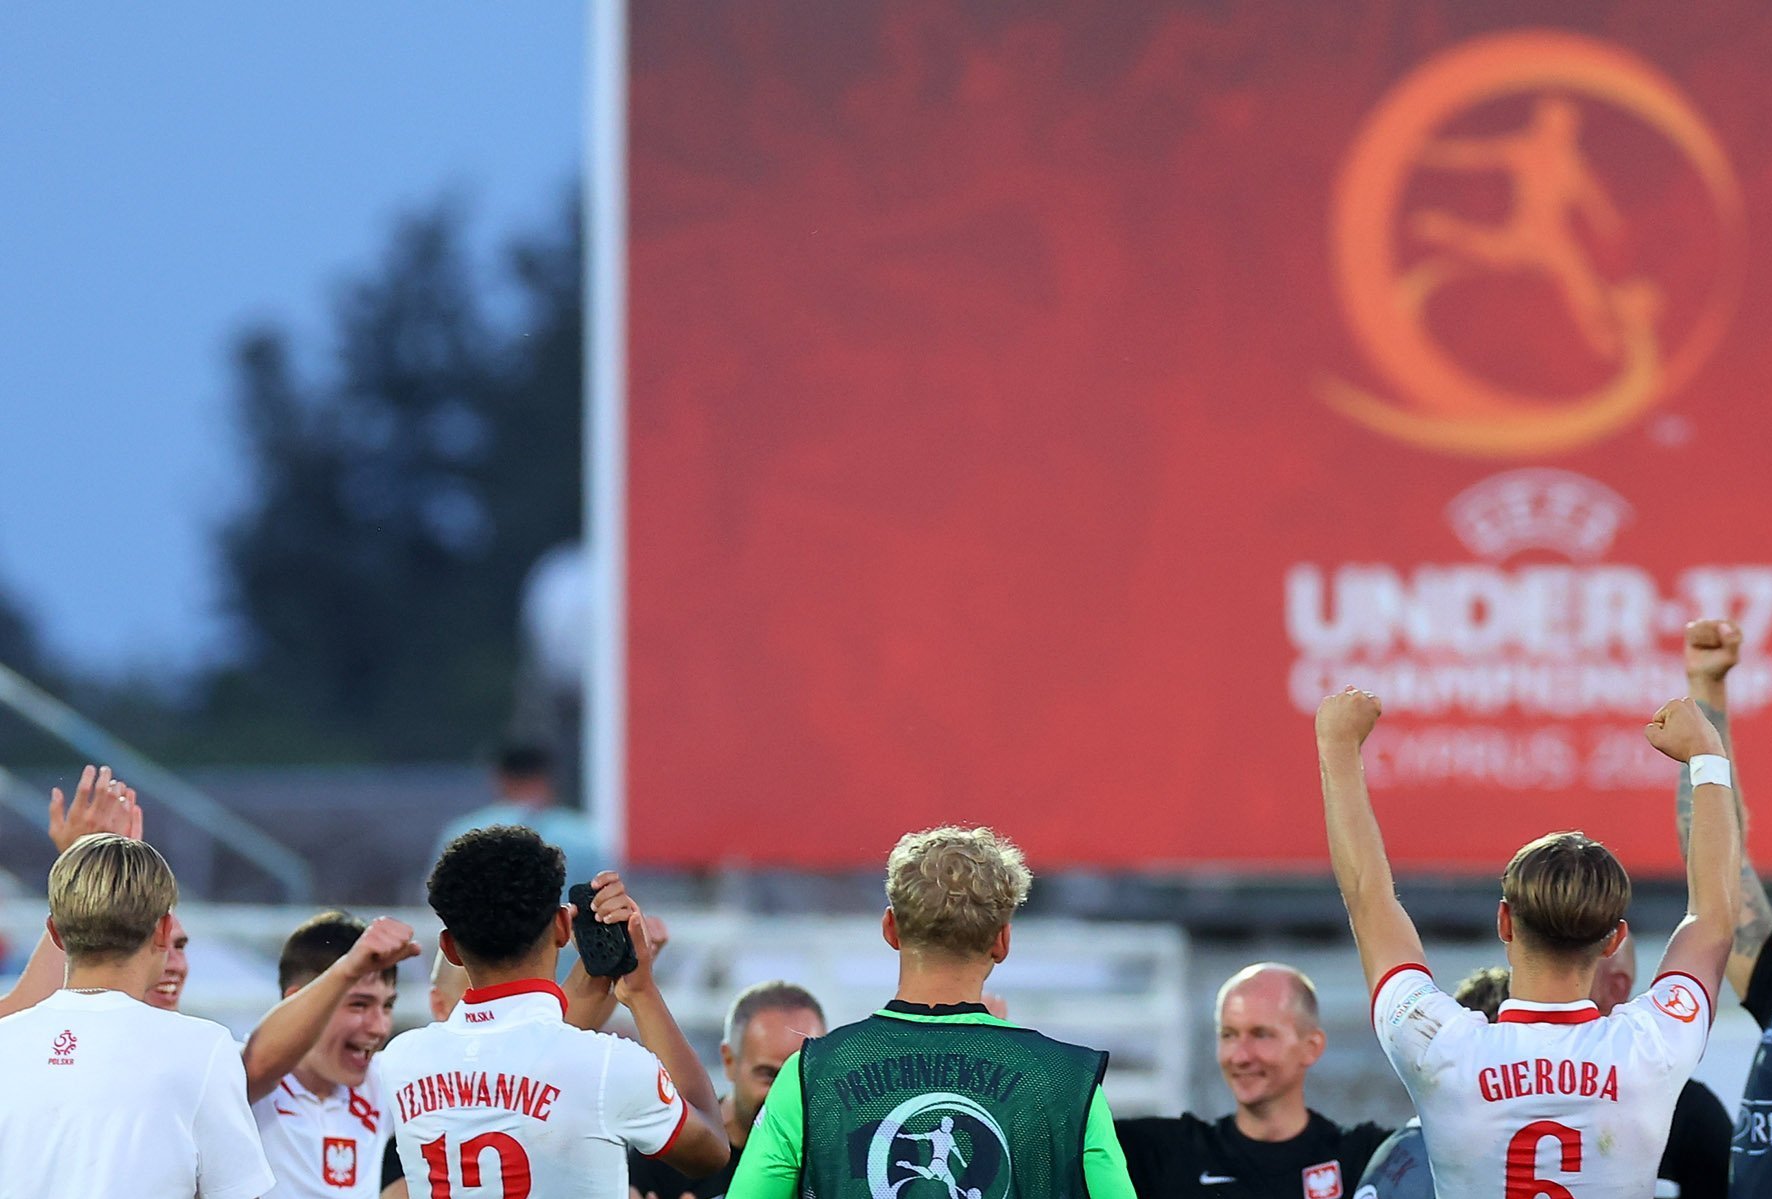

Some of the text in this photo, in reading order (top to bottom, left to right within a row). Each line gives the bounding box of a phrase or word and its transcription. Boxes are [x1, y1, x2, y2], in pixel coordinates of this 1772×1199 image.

[464, 1010, 495, 1023] POLSKA
[396, 1071, 560, 1123] IZUNWANNE
[1478, 1059, 1618, 1101] GIEROBA
